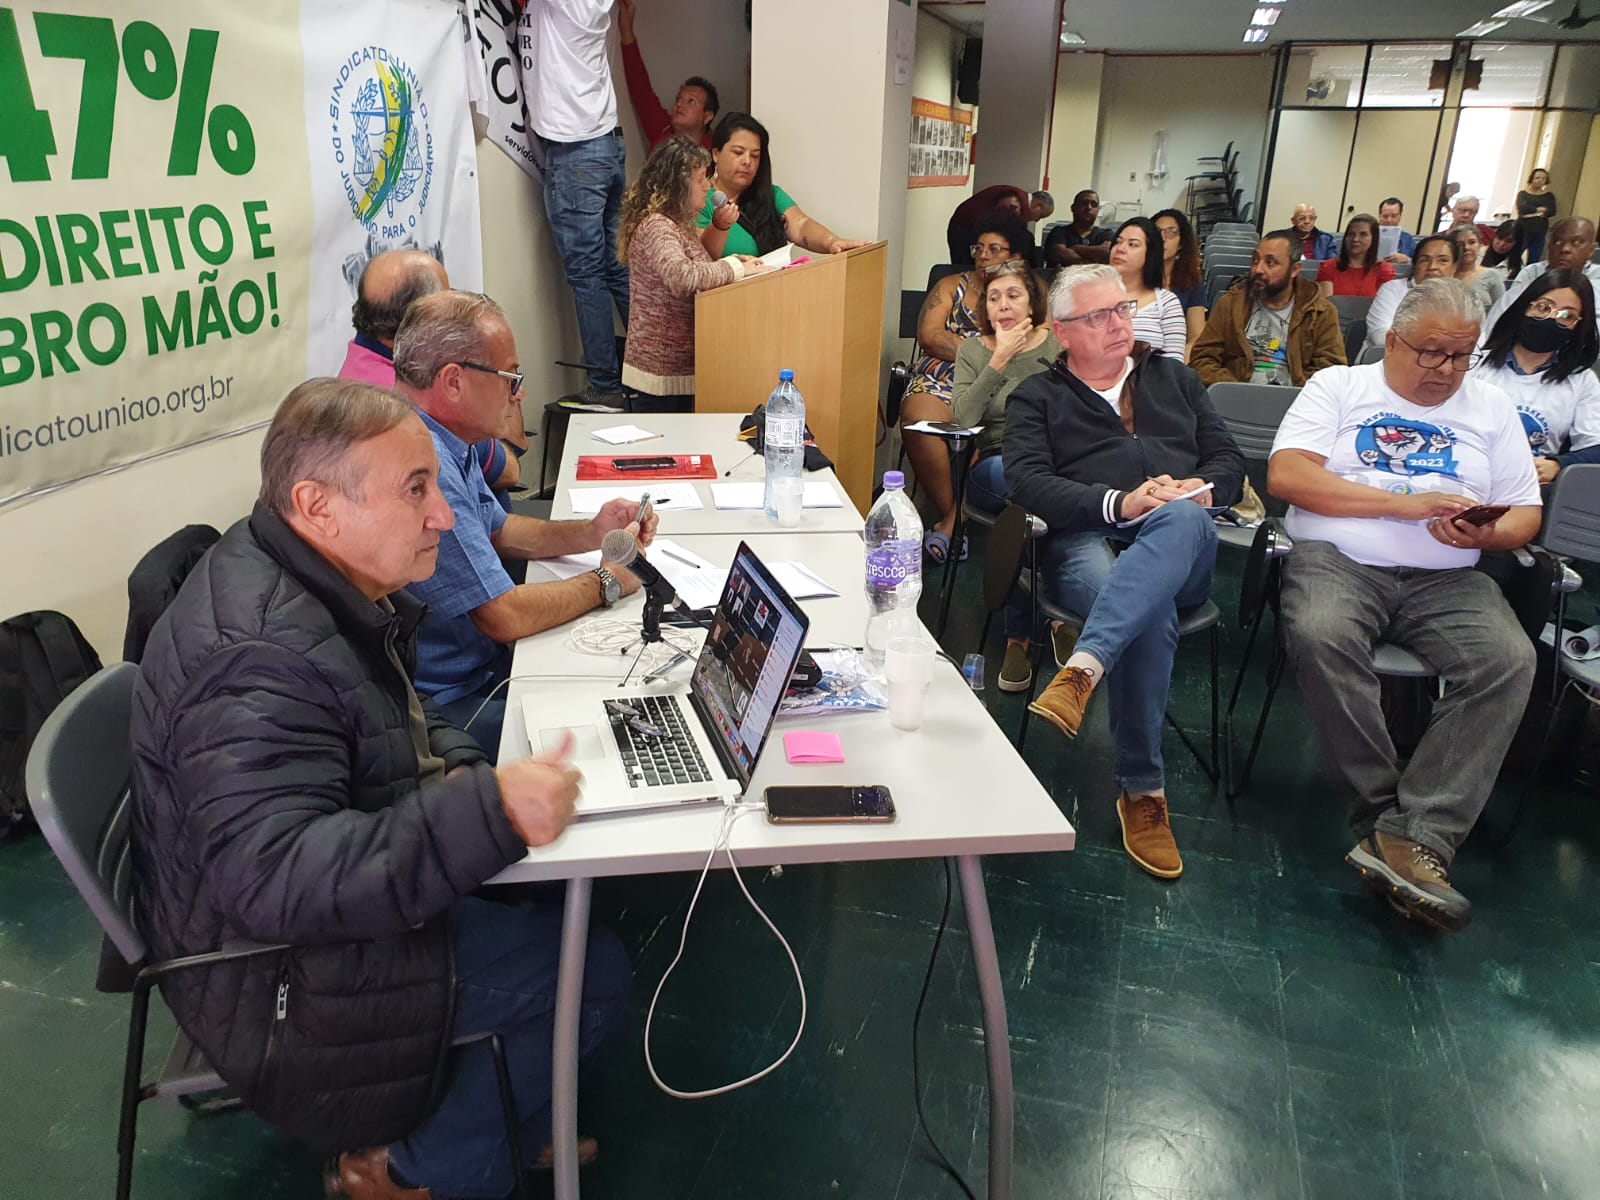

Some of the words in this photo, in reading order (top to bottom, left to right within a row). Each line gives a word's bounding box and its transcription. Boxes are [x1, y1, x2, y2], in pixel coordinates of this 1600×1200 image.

[329, 45, 388, 121] SINDICATO
[332, 137, 345, 164] DO
[382, 222, 406, 239] PARA
[408, 214, 416, 228] O
[0, 203, 234, 294] DIREITO
[242, 200, 275, 260] E
[0, 302, 127, 388] BRO
[142, 269, 280, 356] MÃO!
[1409, 458, 1444, 468] 2023
[866, 560, 906, 578] frescca
